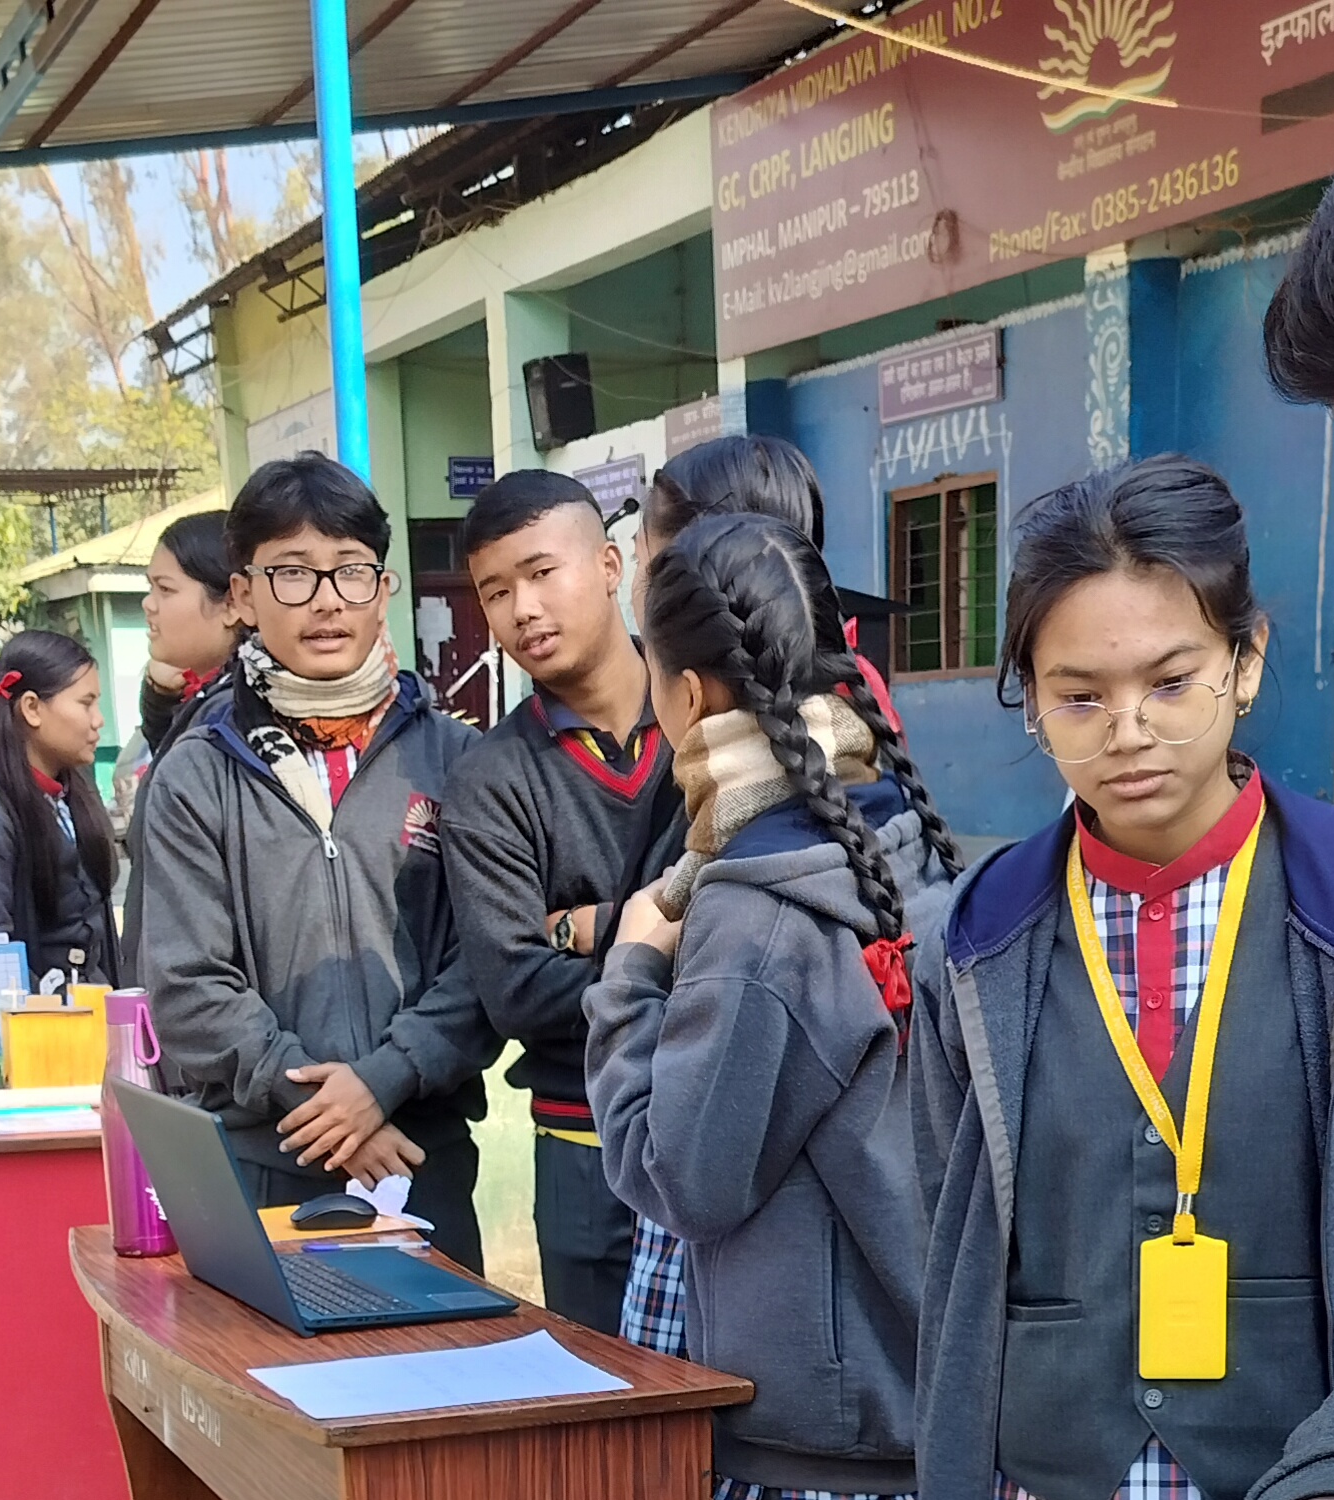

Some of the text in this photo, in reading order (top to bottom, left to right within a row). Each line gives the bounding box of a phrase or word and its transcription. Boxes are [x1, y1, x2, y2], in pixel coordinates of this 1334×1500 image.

[718, 89, 788, 148] KENDRIYA
[790, 46, 876, 114] VIDYALAYA
[879, 10, 948, 72] IMPHAL
[718, 103, 894, 212] GC, CRPF, LANGJING
[989, 147, 1239, 263] Phone/Fax: 0385-2436136
[721, 229, 776, 271] IMPHAL,
[778, 198, 847, 250] MANIPUR
[862, 169, 919, 218] 795113
